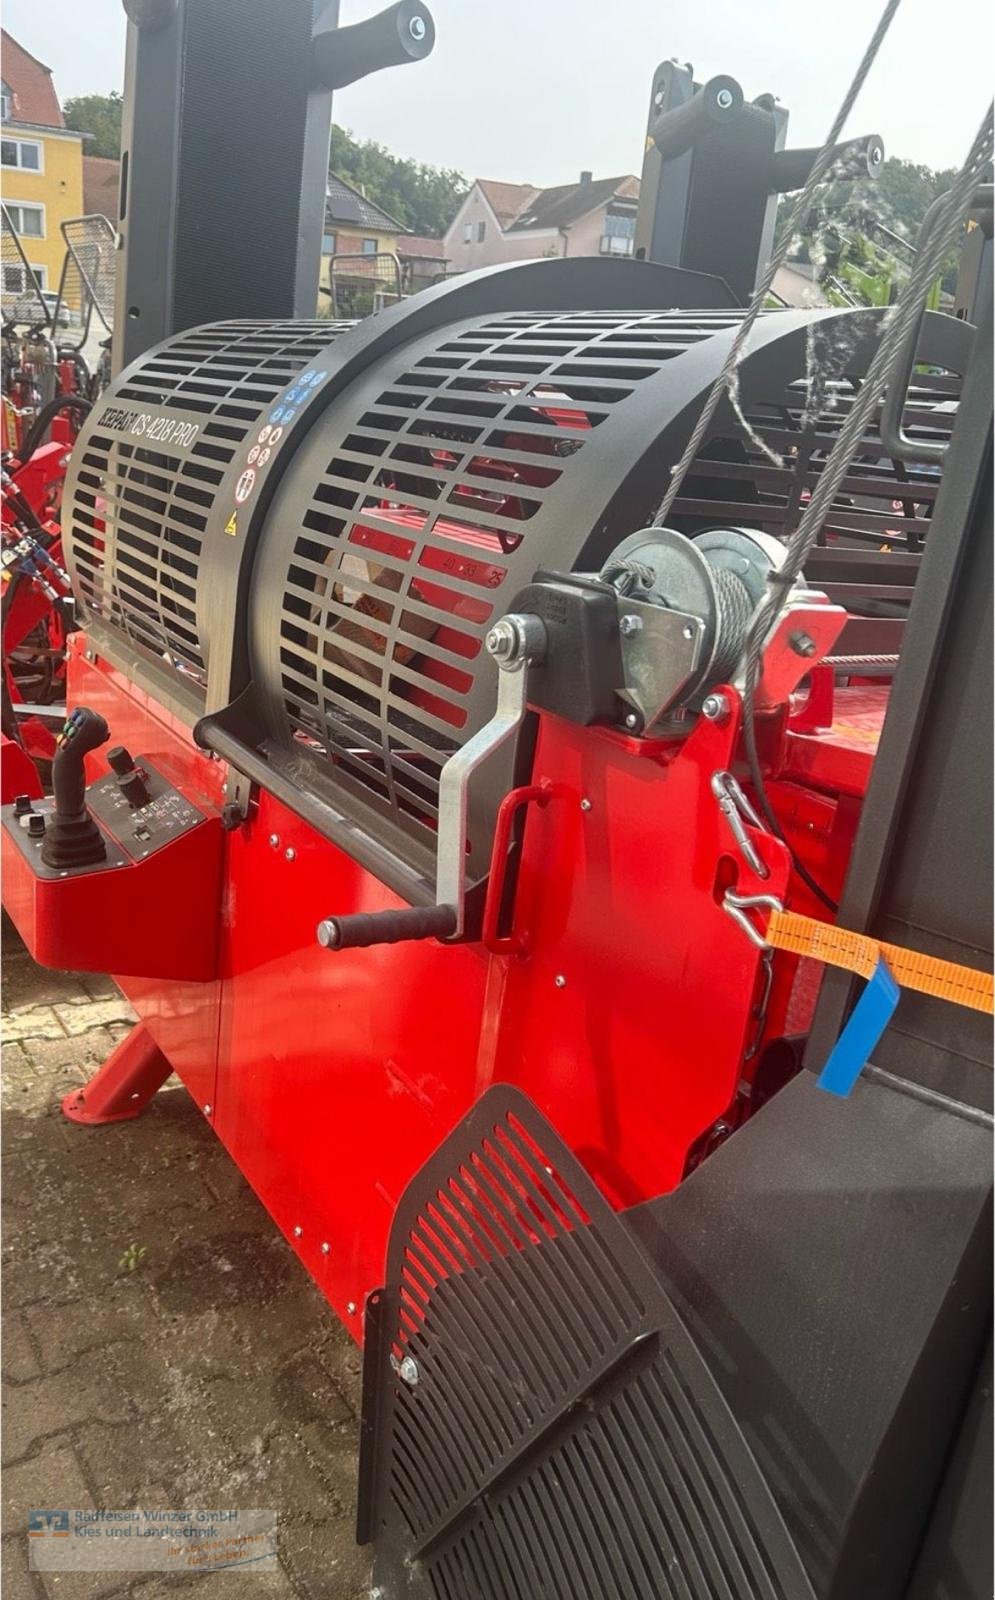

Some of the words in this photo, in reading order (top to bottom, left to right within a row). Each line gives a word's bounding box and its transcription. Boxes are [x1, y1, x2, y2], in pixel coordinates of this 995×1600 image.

[131, 414, 151, 435] CS
[146, 417, 176, 441] 4218
[168, 421, 199, 447] PRO
[488, 570, 503, 586] 25
